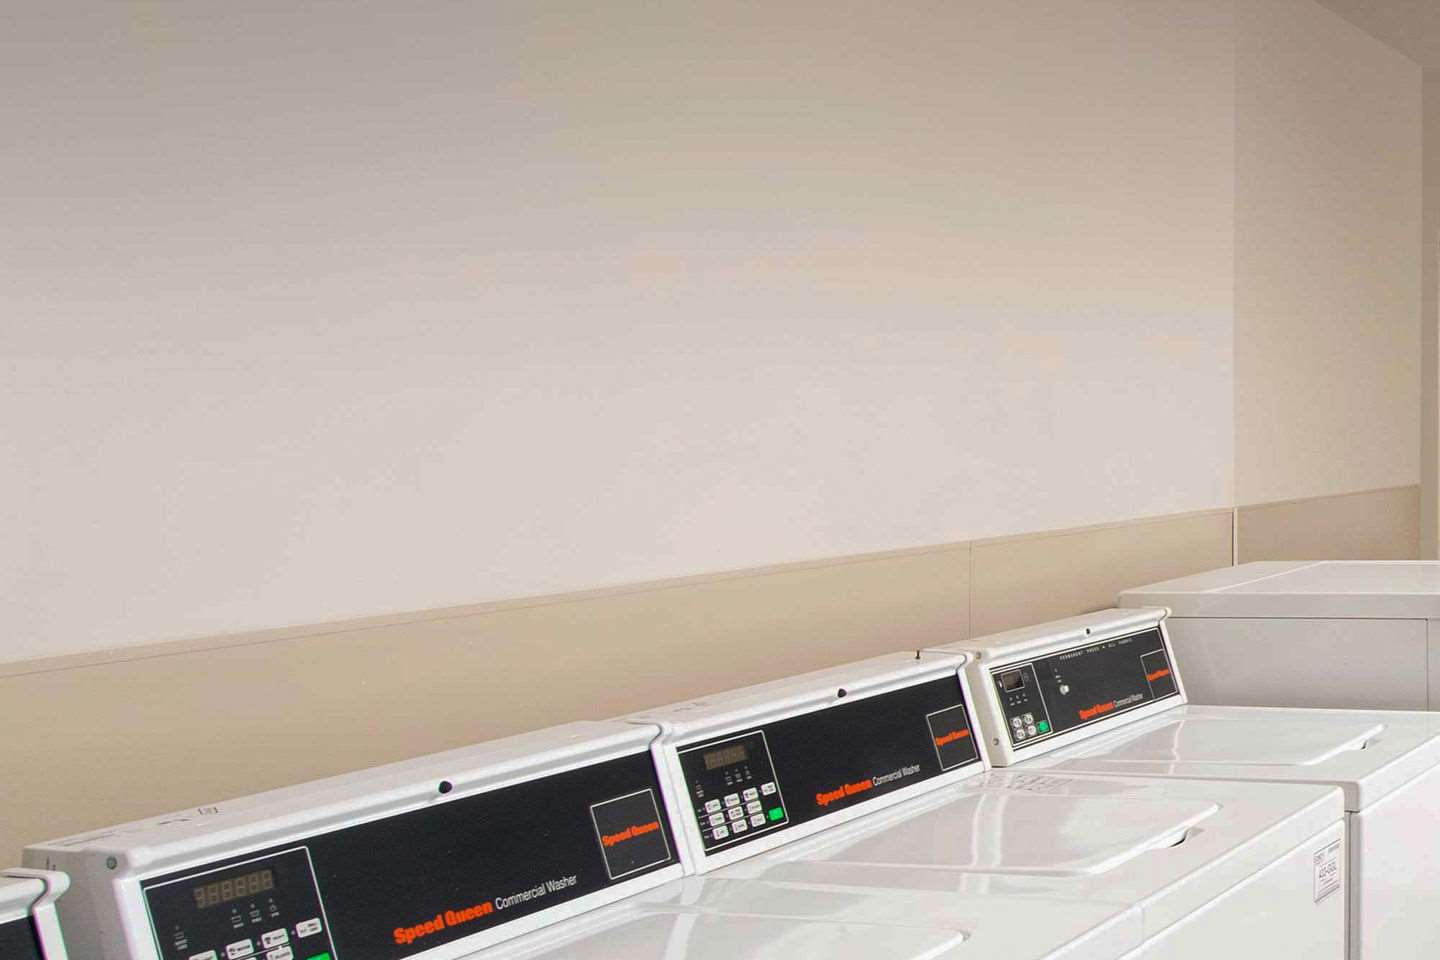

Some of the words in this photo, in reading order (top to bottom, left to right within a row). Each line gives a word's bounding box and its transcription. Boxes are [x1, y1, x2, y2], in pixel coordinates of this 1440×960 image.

[602, 826, 632, 847] Speed
[631, 821, 660, 837] Queen
[393, 914, 445, 944] Speed
[444, 902, 493, 926] Queen
[495, 882, 547, 910] Commercial
[545, 875, 577, 893] Washer
